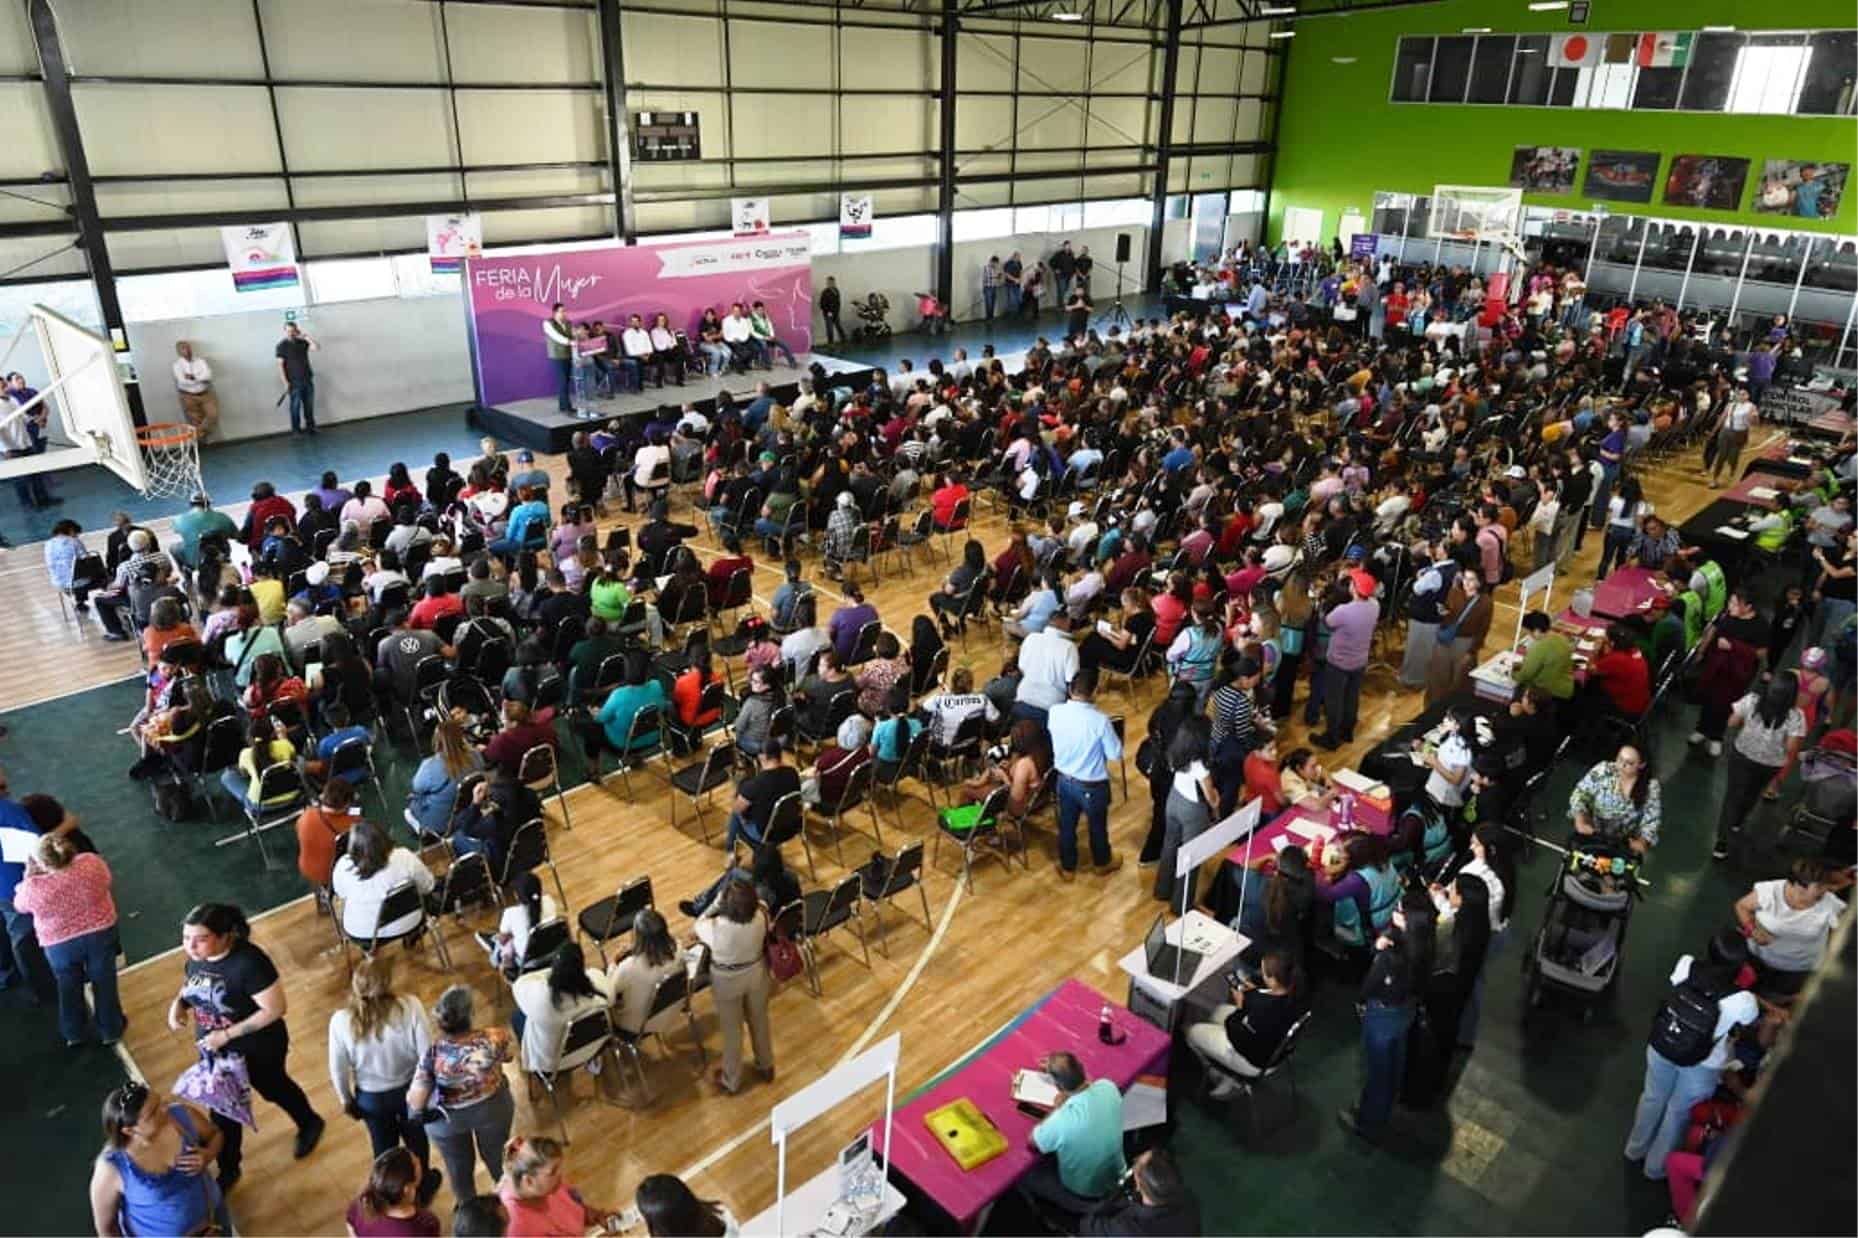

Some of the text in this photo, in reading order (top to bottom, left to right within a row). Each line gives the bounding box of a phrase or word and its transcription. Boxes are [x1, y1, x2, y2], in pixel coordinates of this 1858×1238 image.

[475, 266, 531, 287] FERIA
[495, 263, 603, 303] de la Mujer
